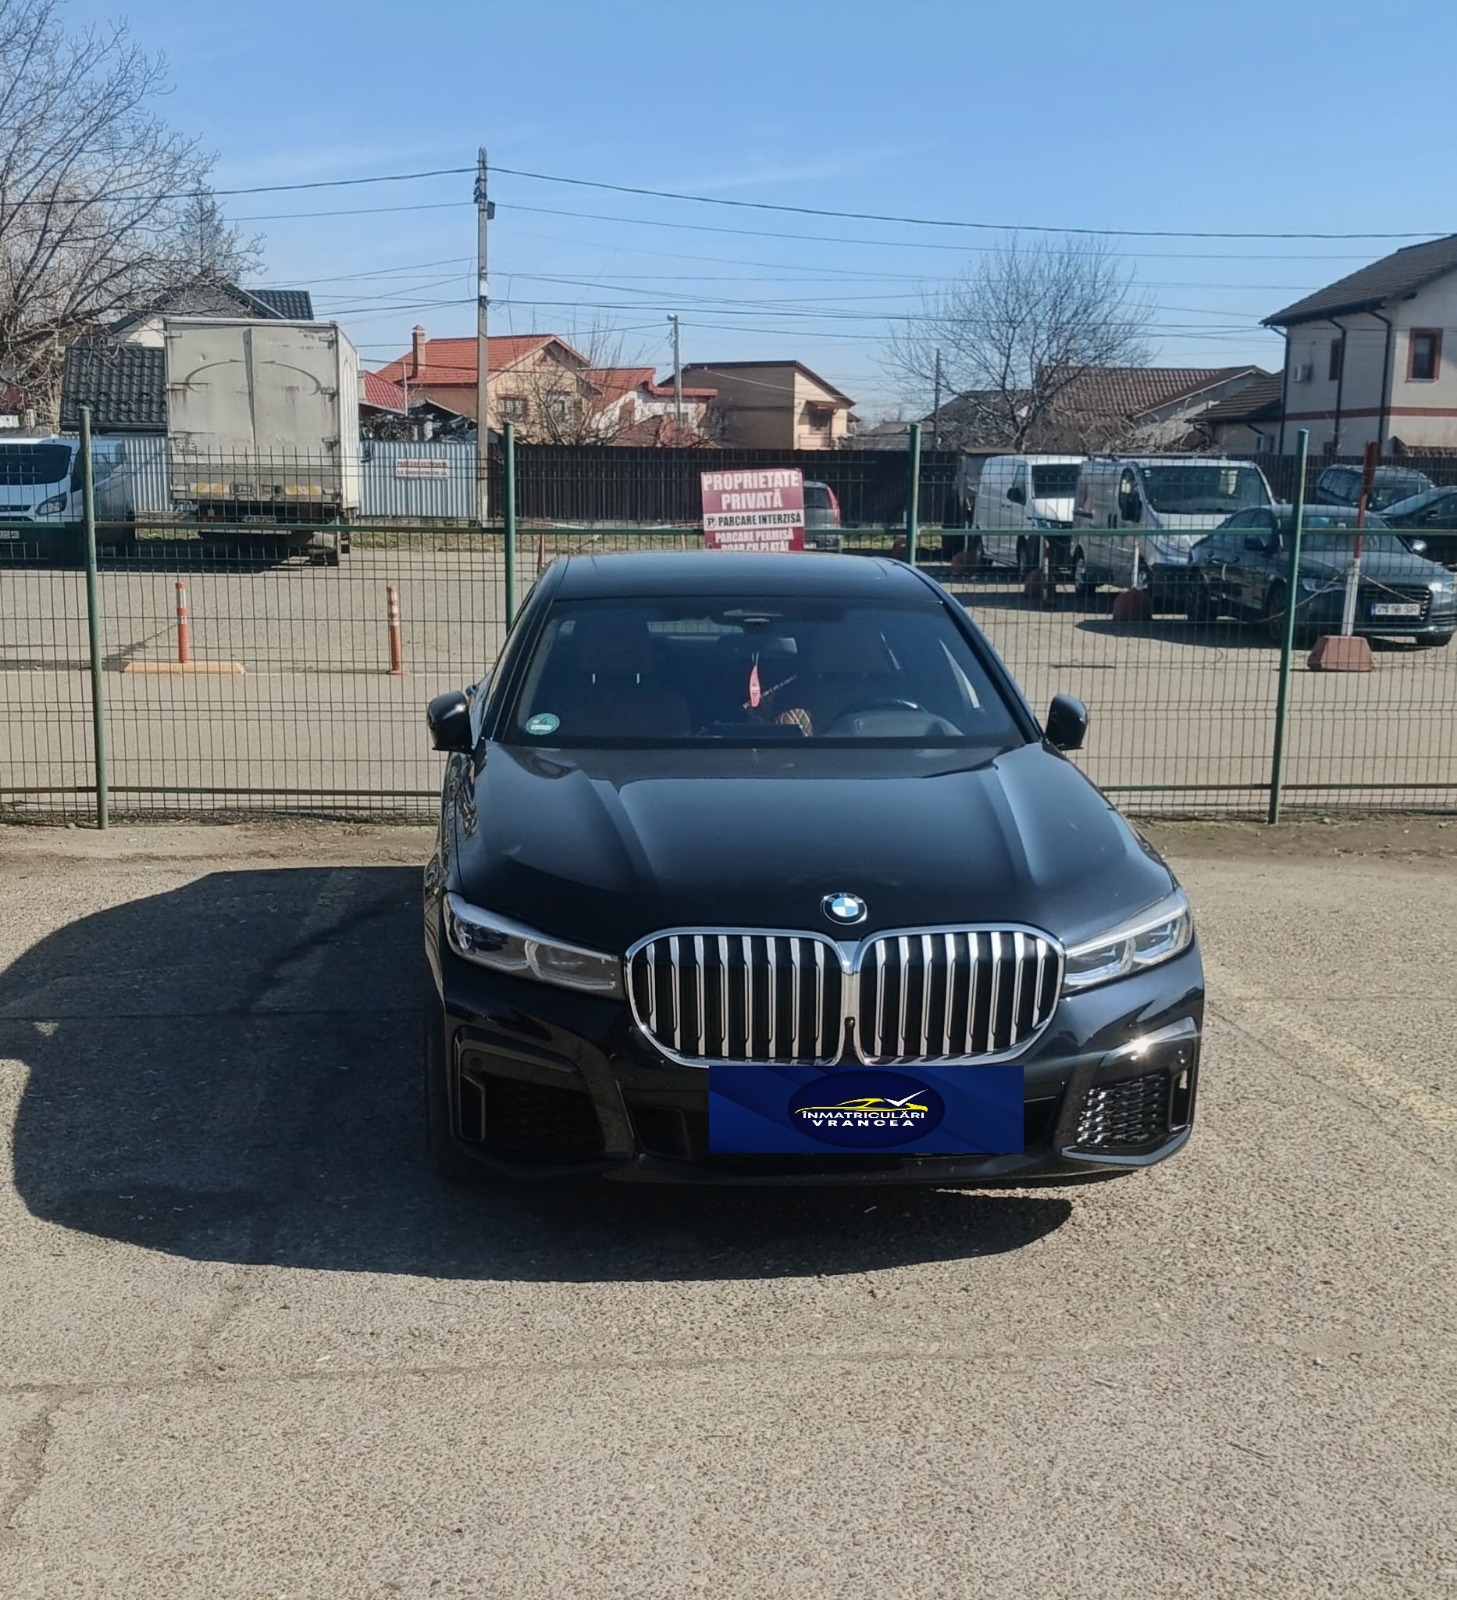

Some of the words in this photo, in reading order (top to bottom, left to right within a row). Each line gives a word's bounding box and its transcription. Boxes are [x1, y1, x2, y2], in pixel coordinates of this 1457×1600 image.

[703, 472, 799, 491] PROPRIETATE
[721, 489, 783, 510] PRIVATĂ
[718, 515, 757, 527] PARCARE
[758, 512, 802, 525] INTERZISĂ
[715, 531, 754, 544] PARCARE
